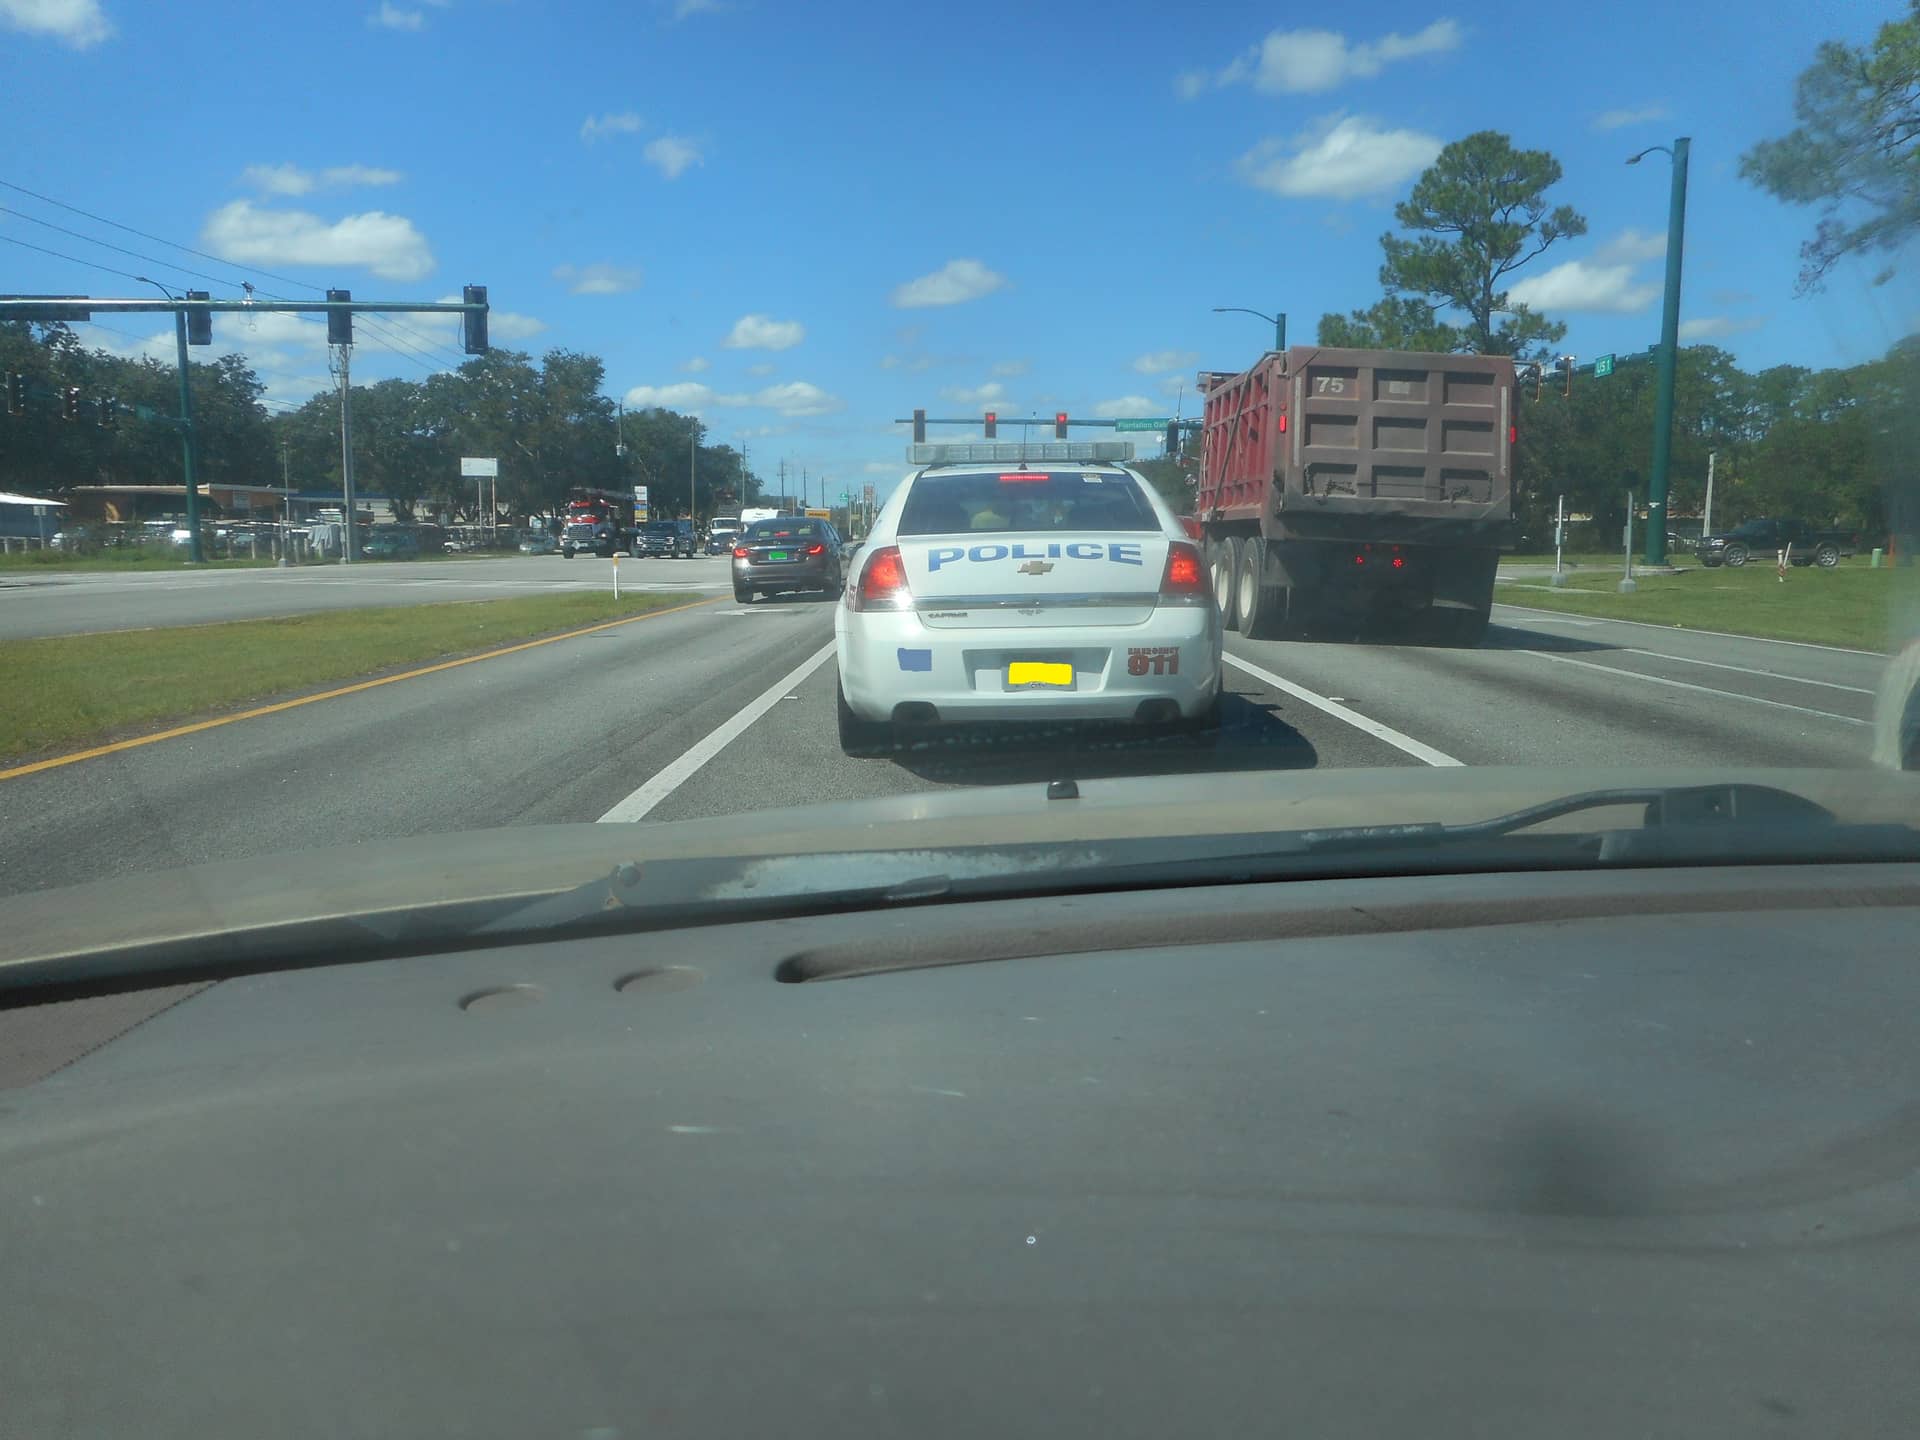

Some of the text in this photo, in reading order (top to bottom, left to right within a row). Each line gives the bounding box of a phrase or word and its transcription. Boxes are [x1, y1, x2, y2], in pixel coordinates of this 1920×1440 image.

[1316, 376, 1345, 393] 75
[928, 543, 1143, 572] POLICE
[1127, 654, 1180, 676] 911
